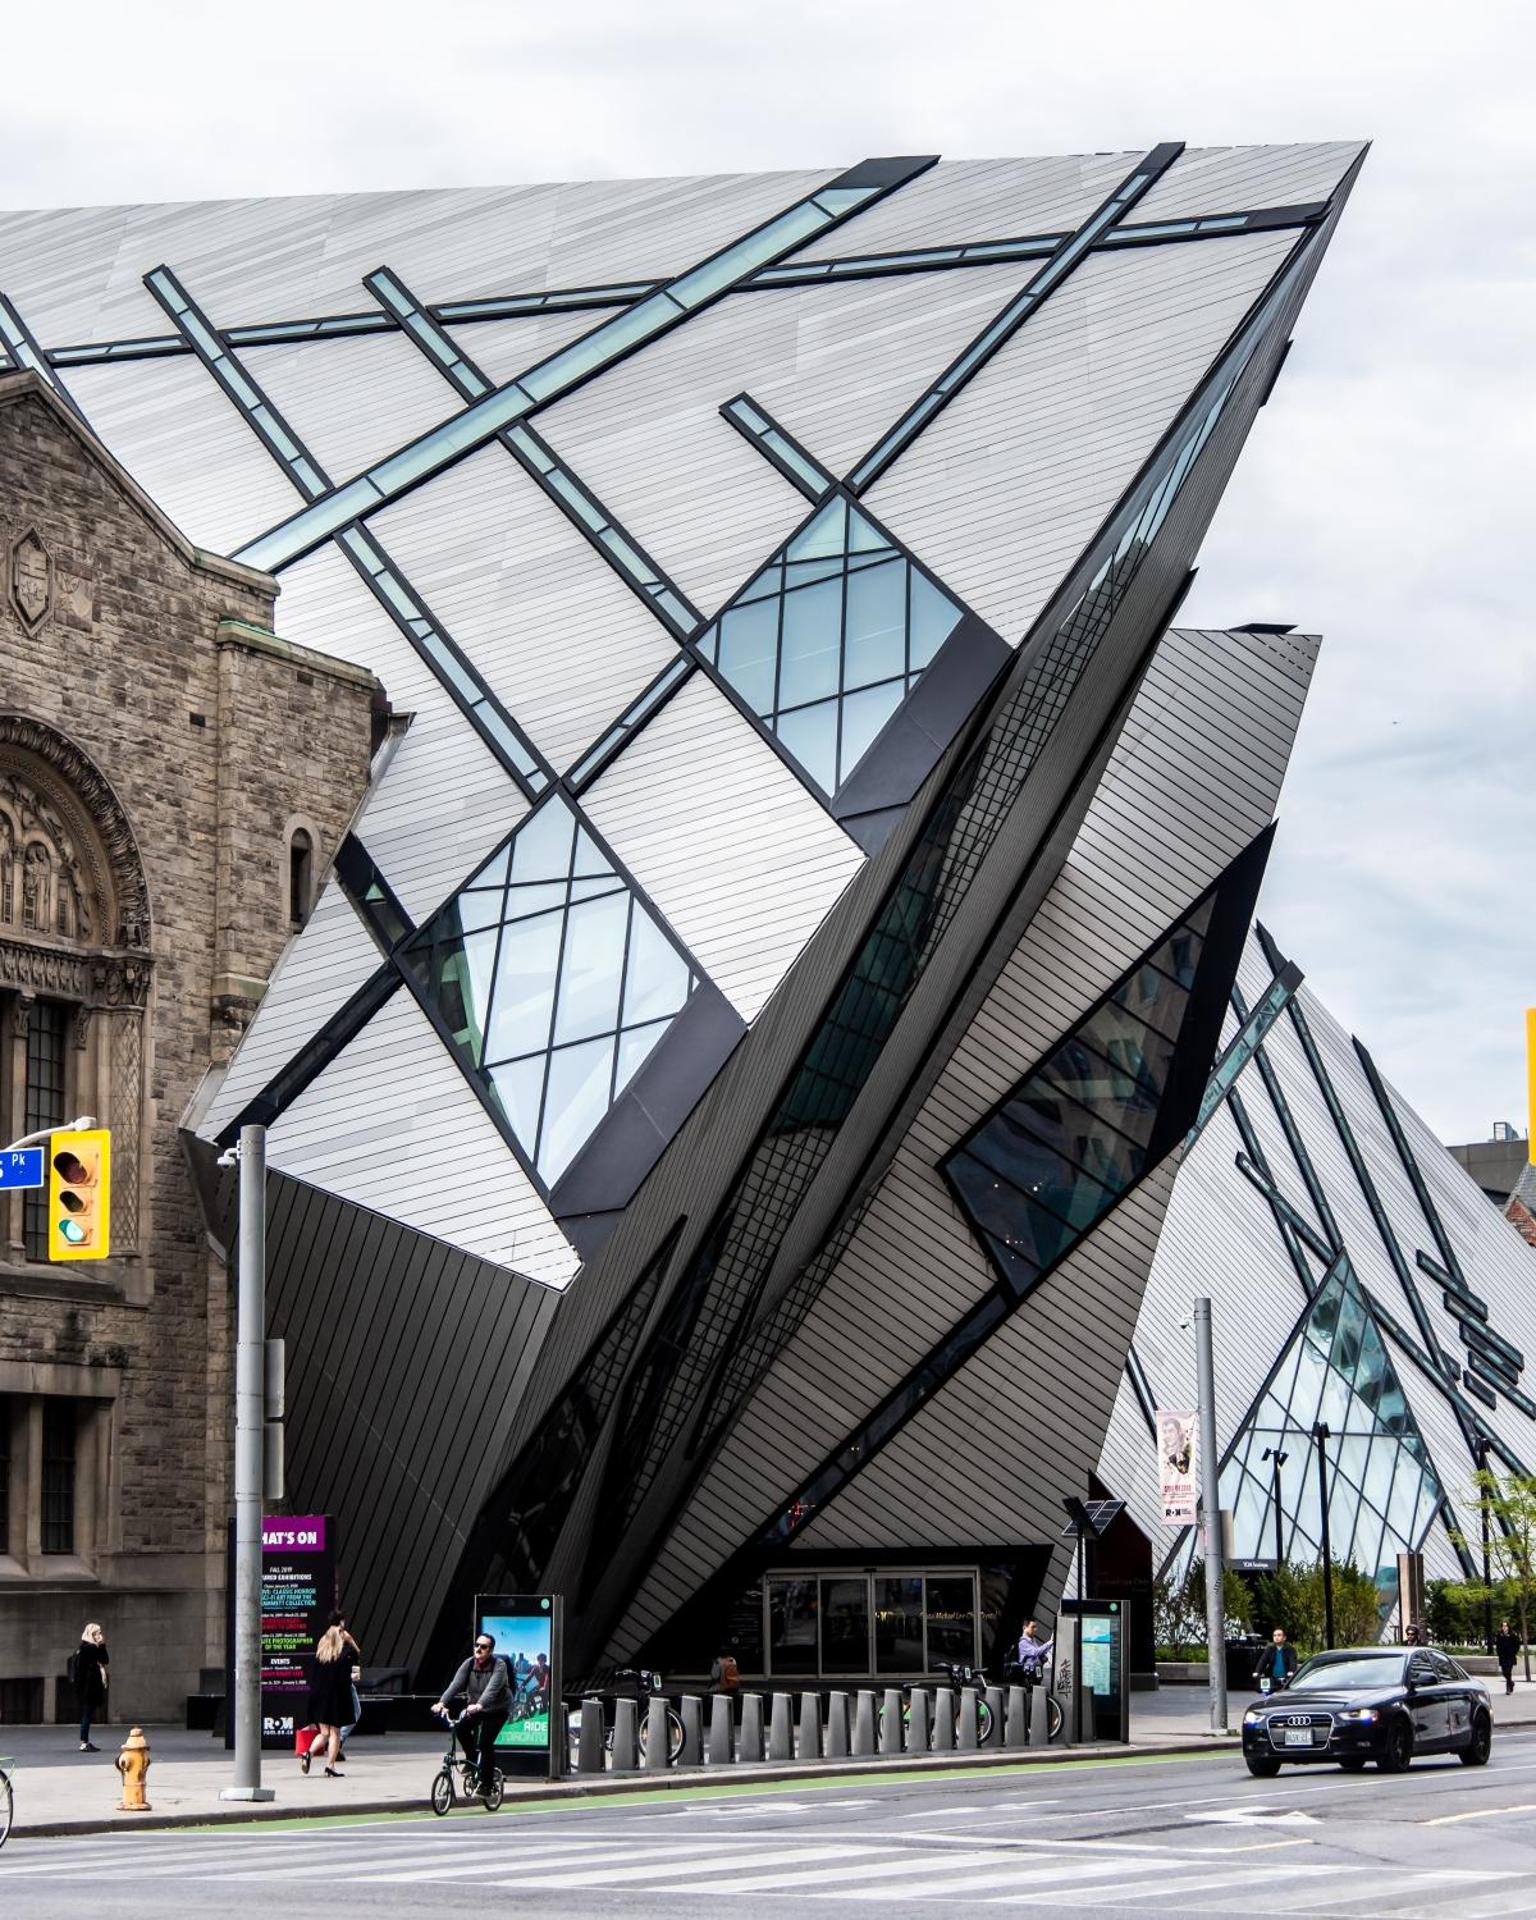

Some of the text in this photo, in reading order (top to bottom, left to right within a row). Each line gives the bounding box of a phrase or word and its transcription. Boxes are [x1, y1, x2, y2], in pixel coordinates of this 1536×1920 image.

[12, 1153, 26, 1167] Pk
[262, 1531, 317, 1545] HAT'S ON
[524, 1721, 548, 1731] RIDE
